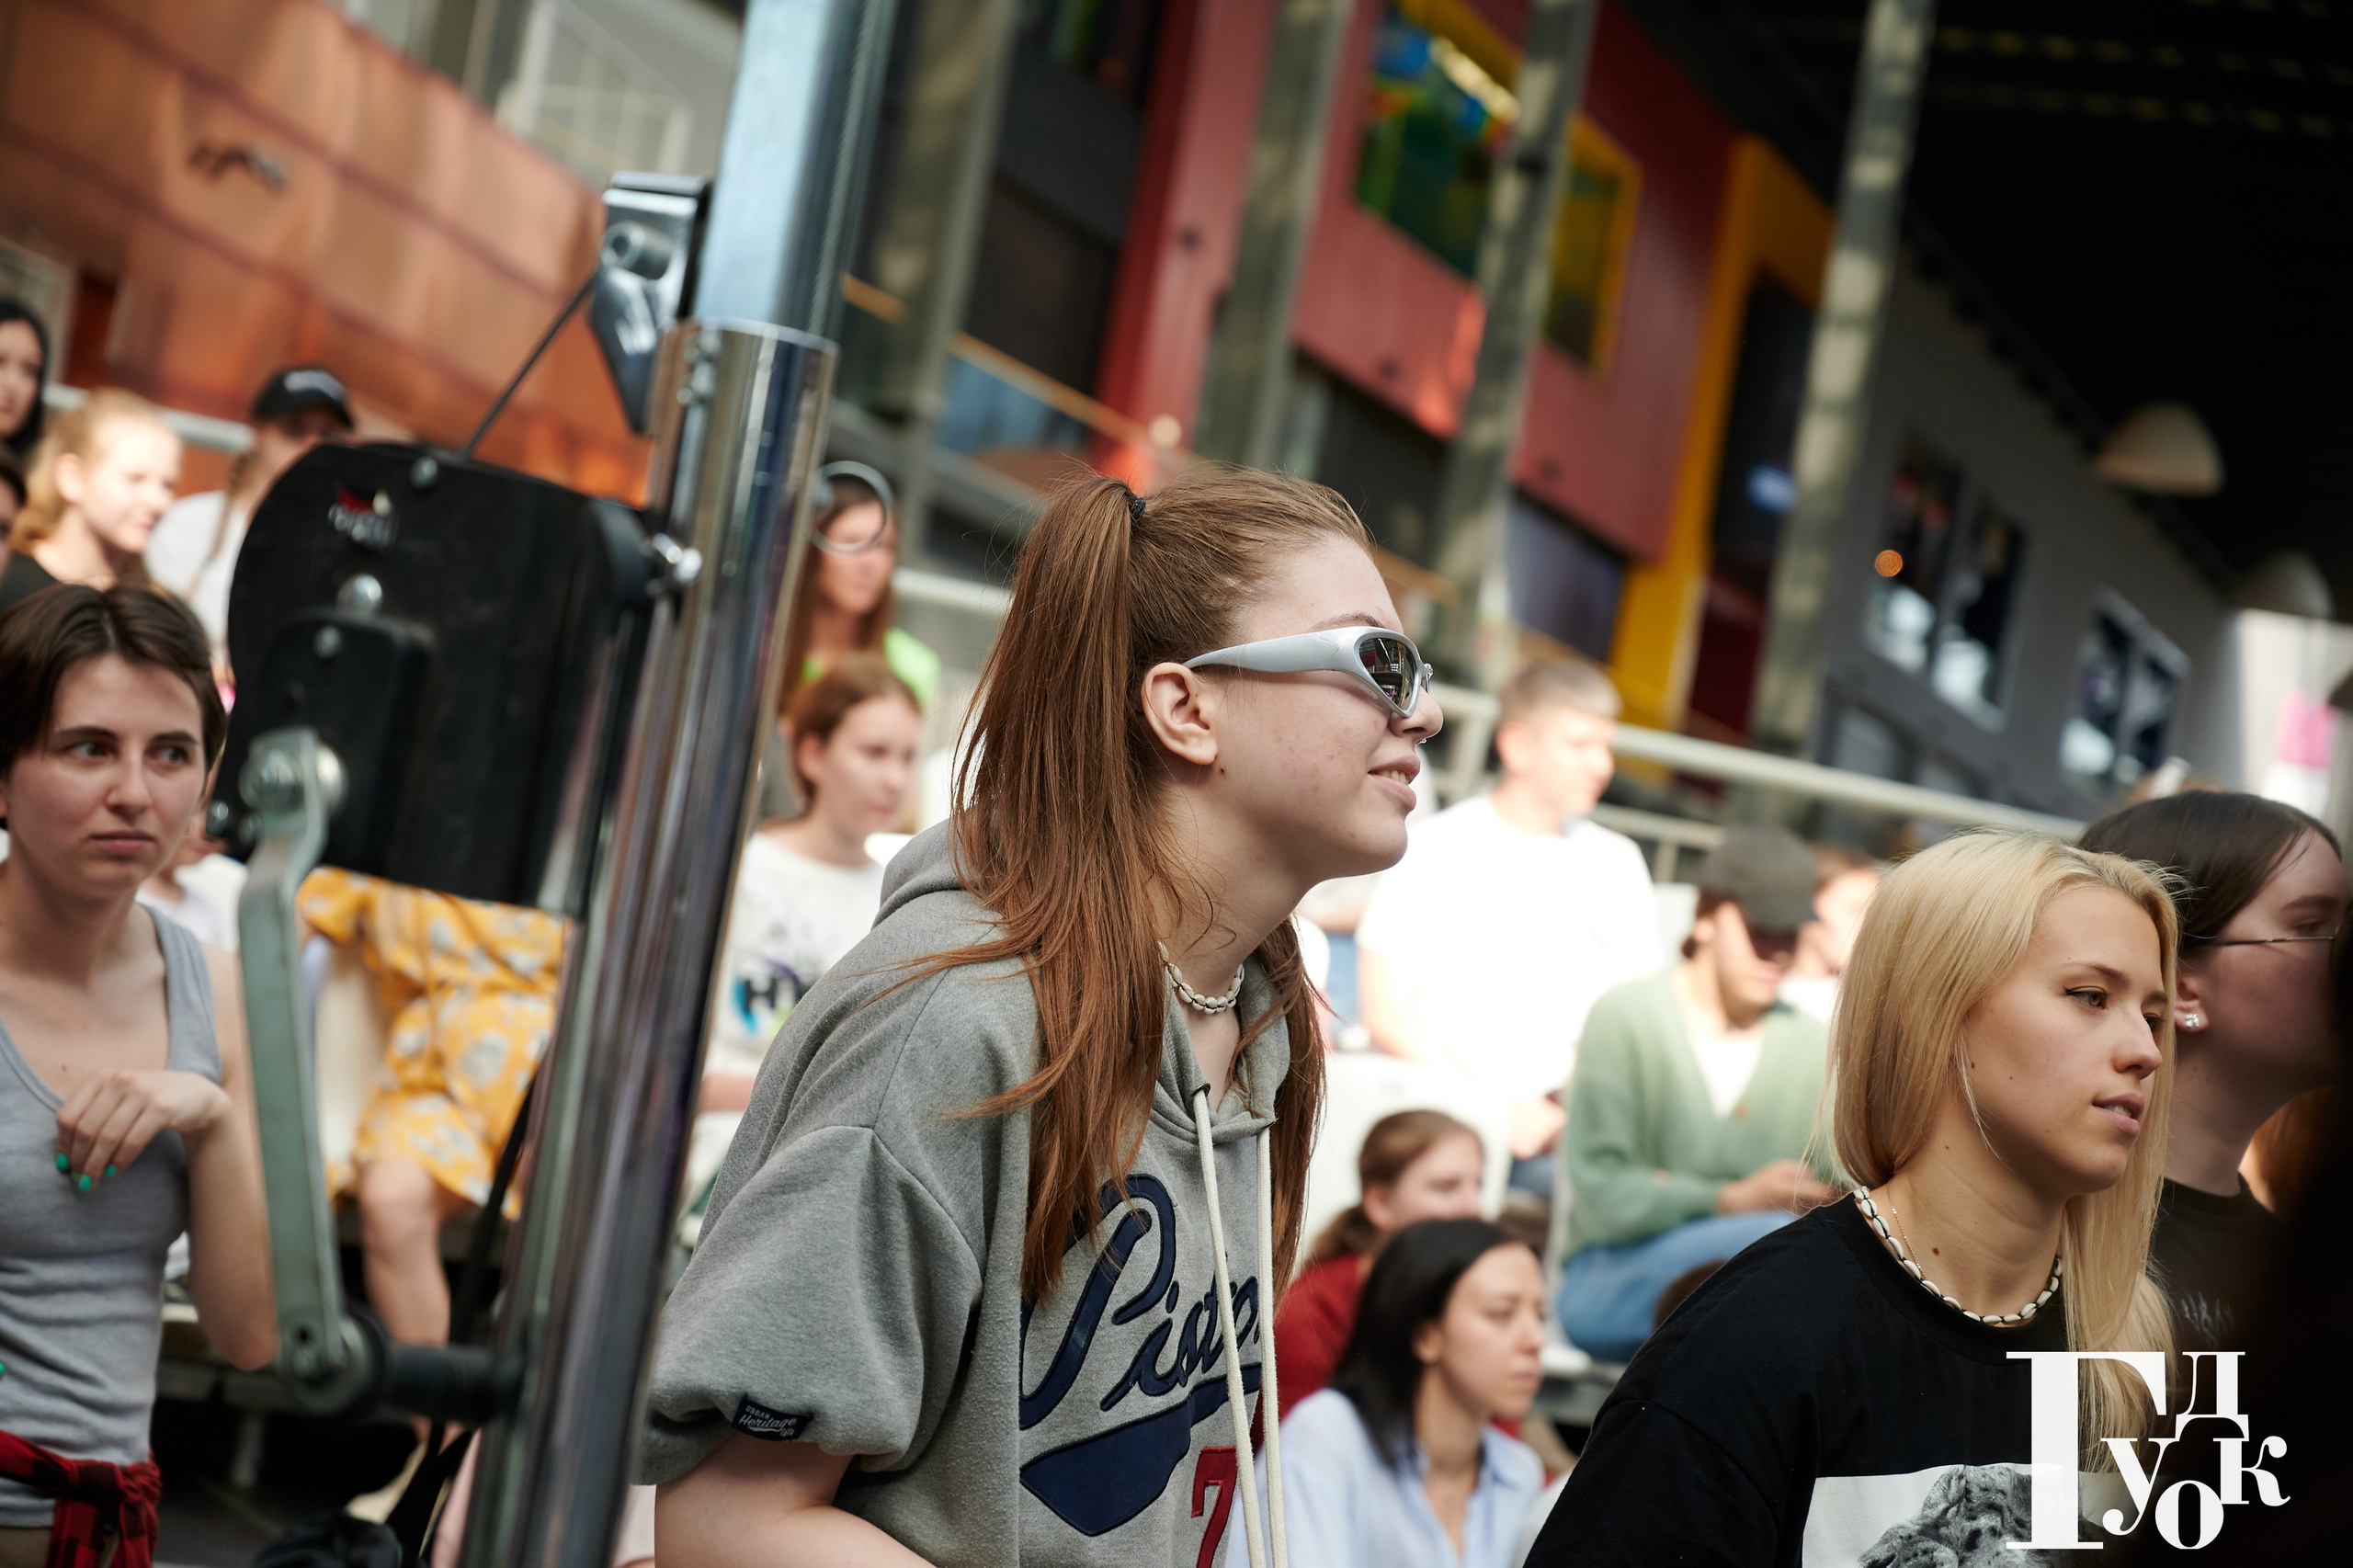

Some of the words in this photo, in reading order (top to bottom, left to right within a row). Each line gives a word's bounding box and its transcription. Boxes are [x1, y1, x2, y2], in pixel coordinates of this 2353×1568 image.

[1019, 1173, 1261, 1430] Pisto
[738, 1414, 798, 1428] Heritage
[745, 1405, 771, 1420] URBAN
[1191, 1446, 1238, 1568] 7
